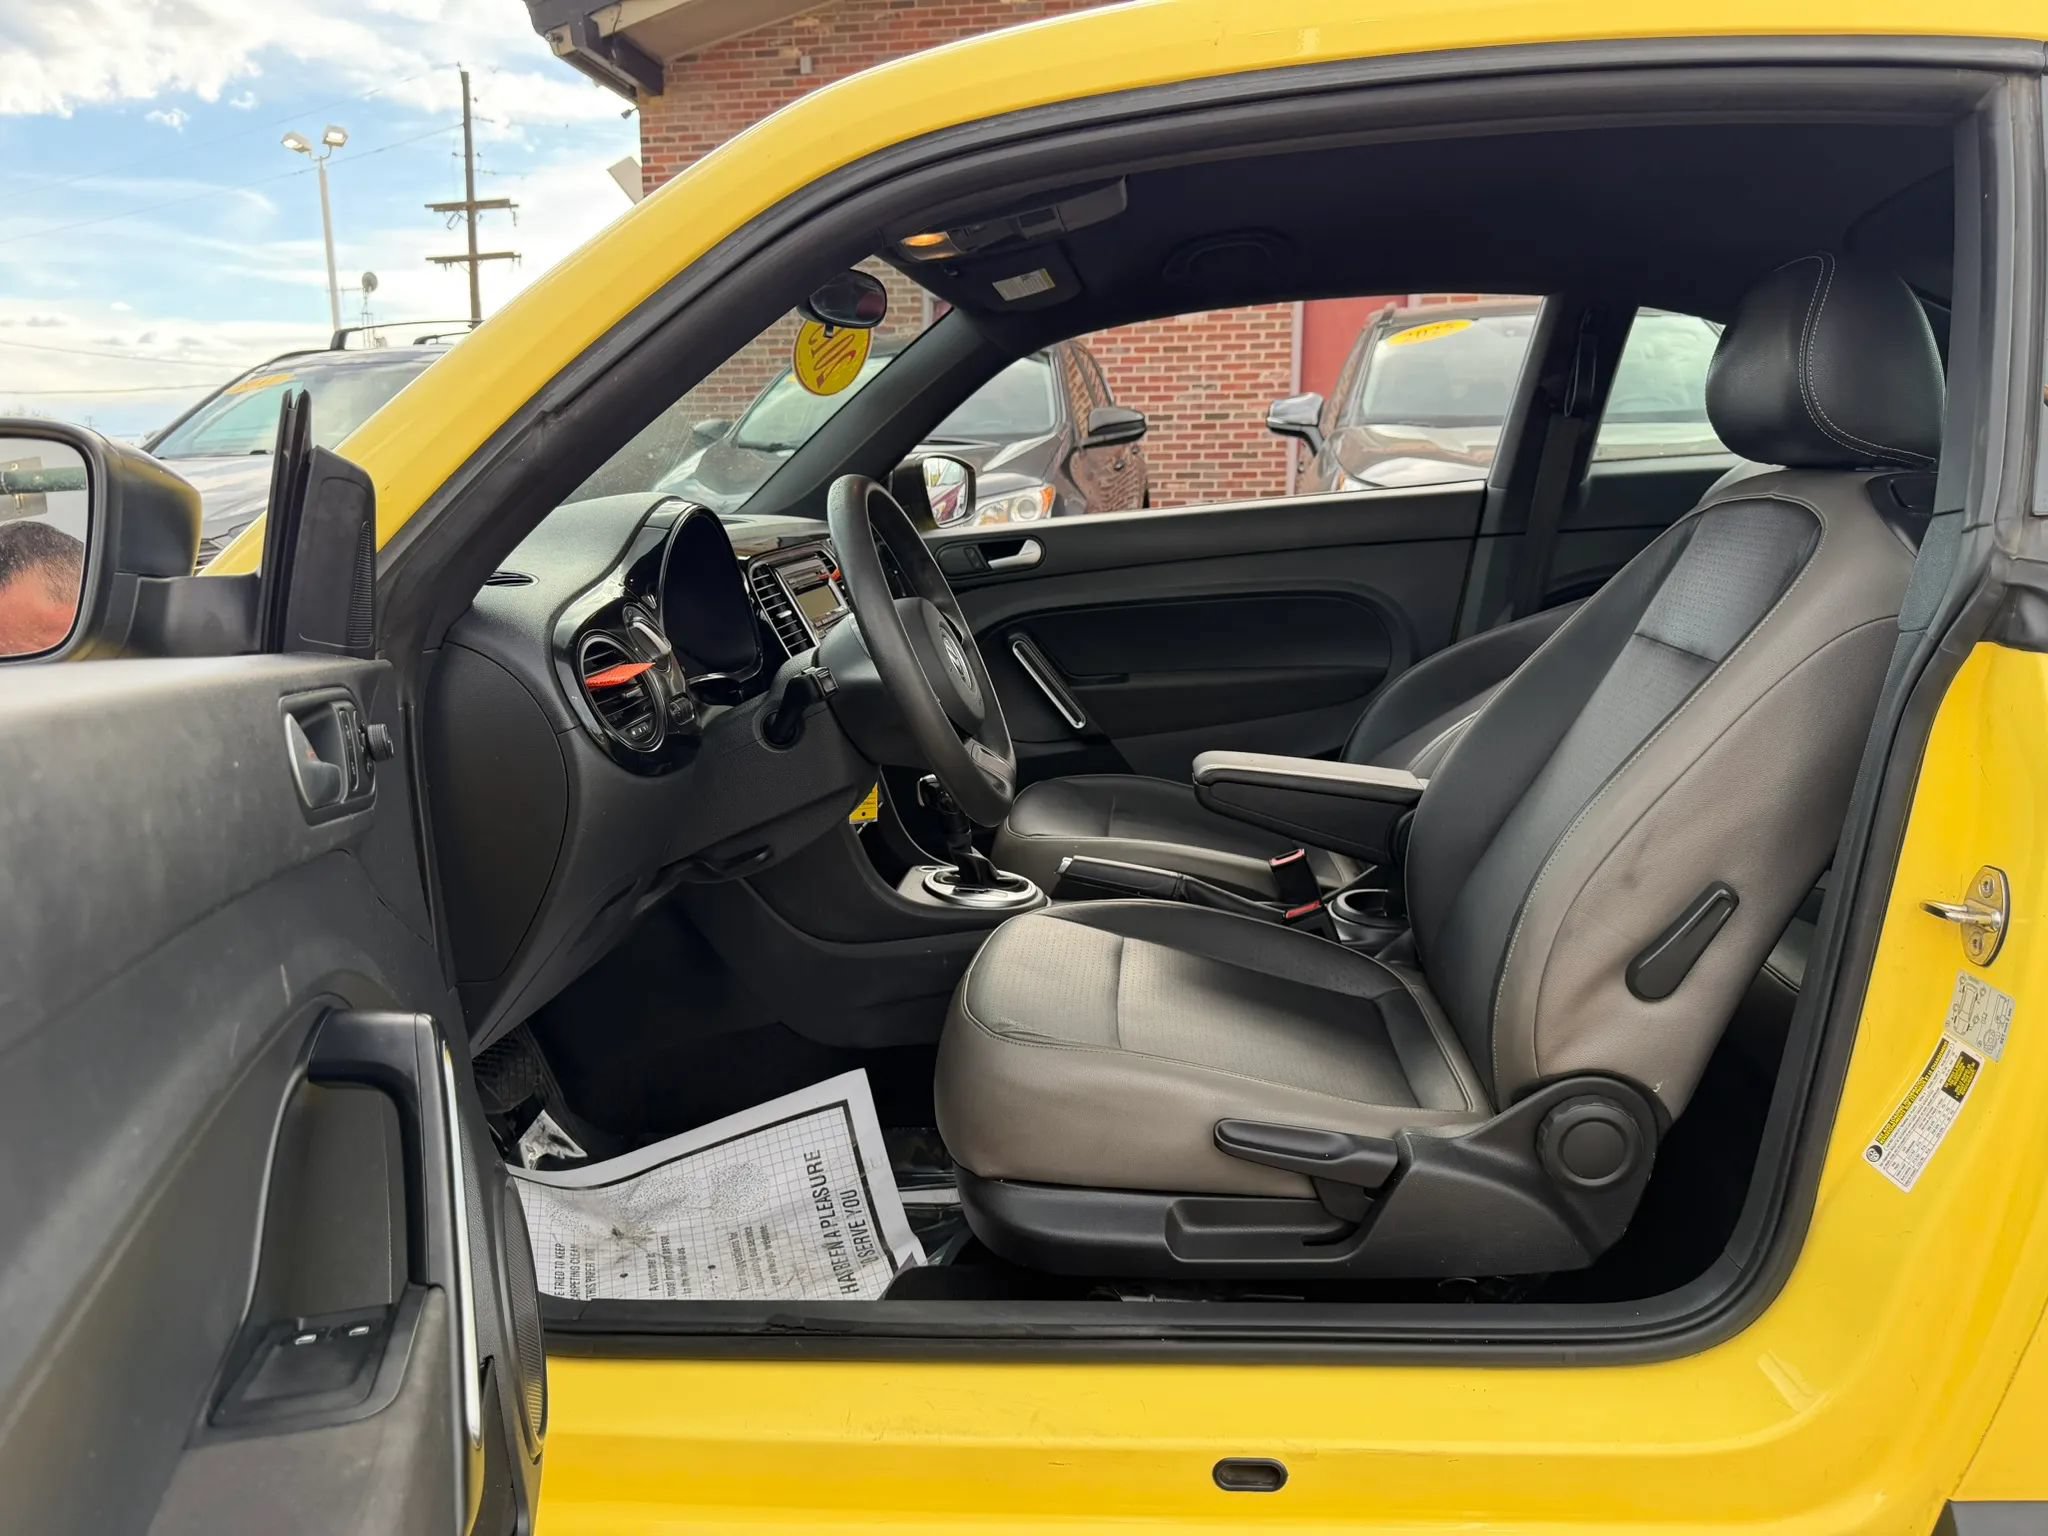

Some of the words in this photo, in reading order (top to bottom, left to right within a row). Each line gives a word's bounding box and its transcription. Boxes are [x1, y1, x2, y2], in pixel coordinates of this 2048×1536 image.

[803, 1149, 838, 1229] PLEASURE
[839, 1188, 863, 1219] YOU
[823, 1230, 842, 1239] A
[848, 1219, 877, 1260] SERVE
[554, 1242, 565, 1259] KEEP
[825, 1241, 852, 1272] BEEN
[554, 1260, 565, 1269] TO
[554, 1270, 565, 1290] TRIED
[585, 1282, 596, 1299] THIS
